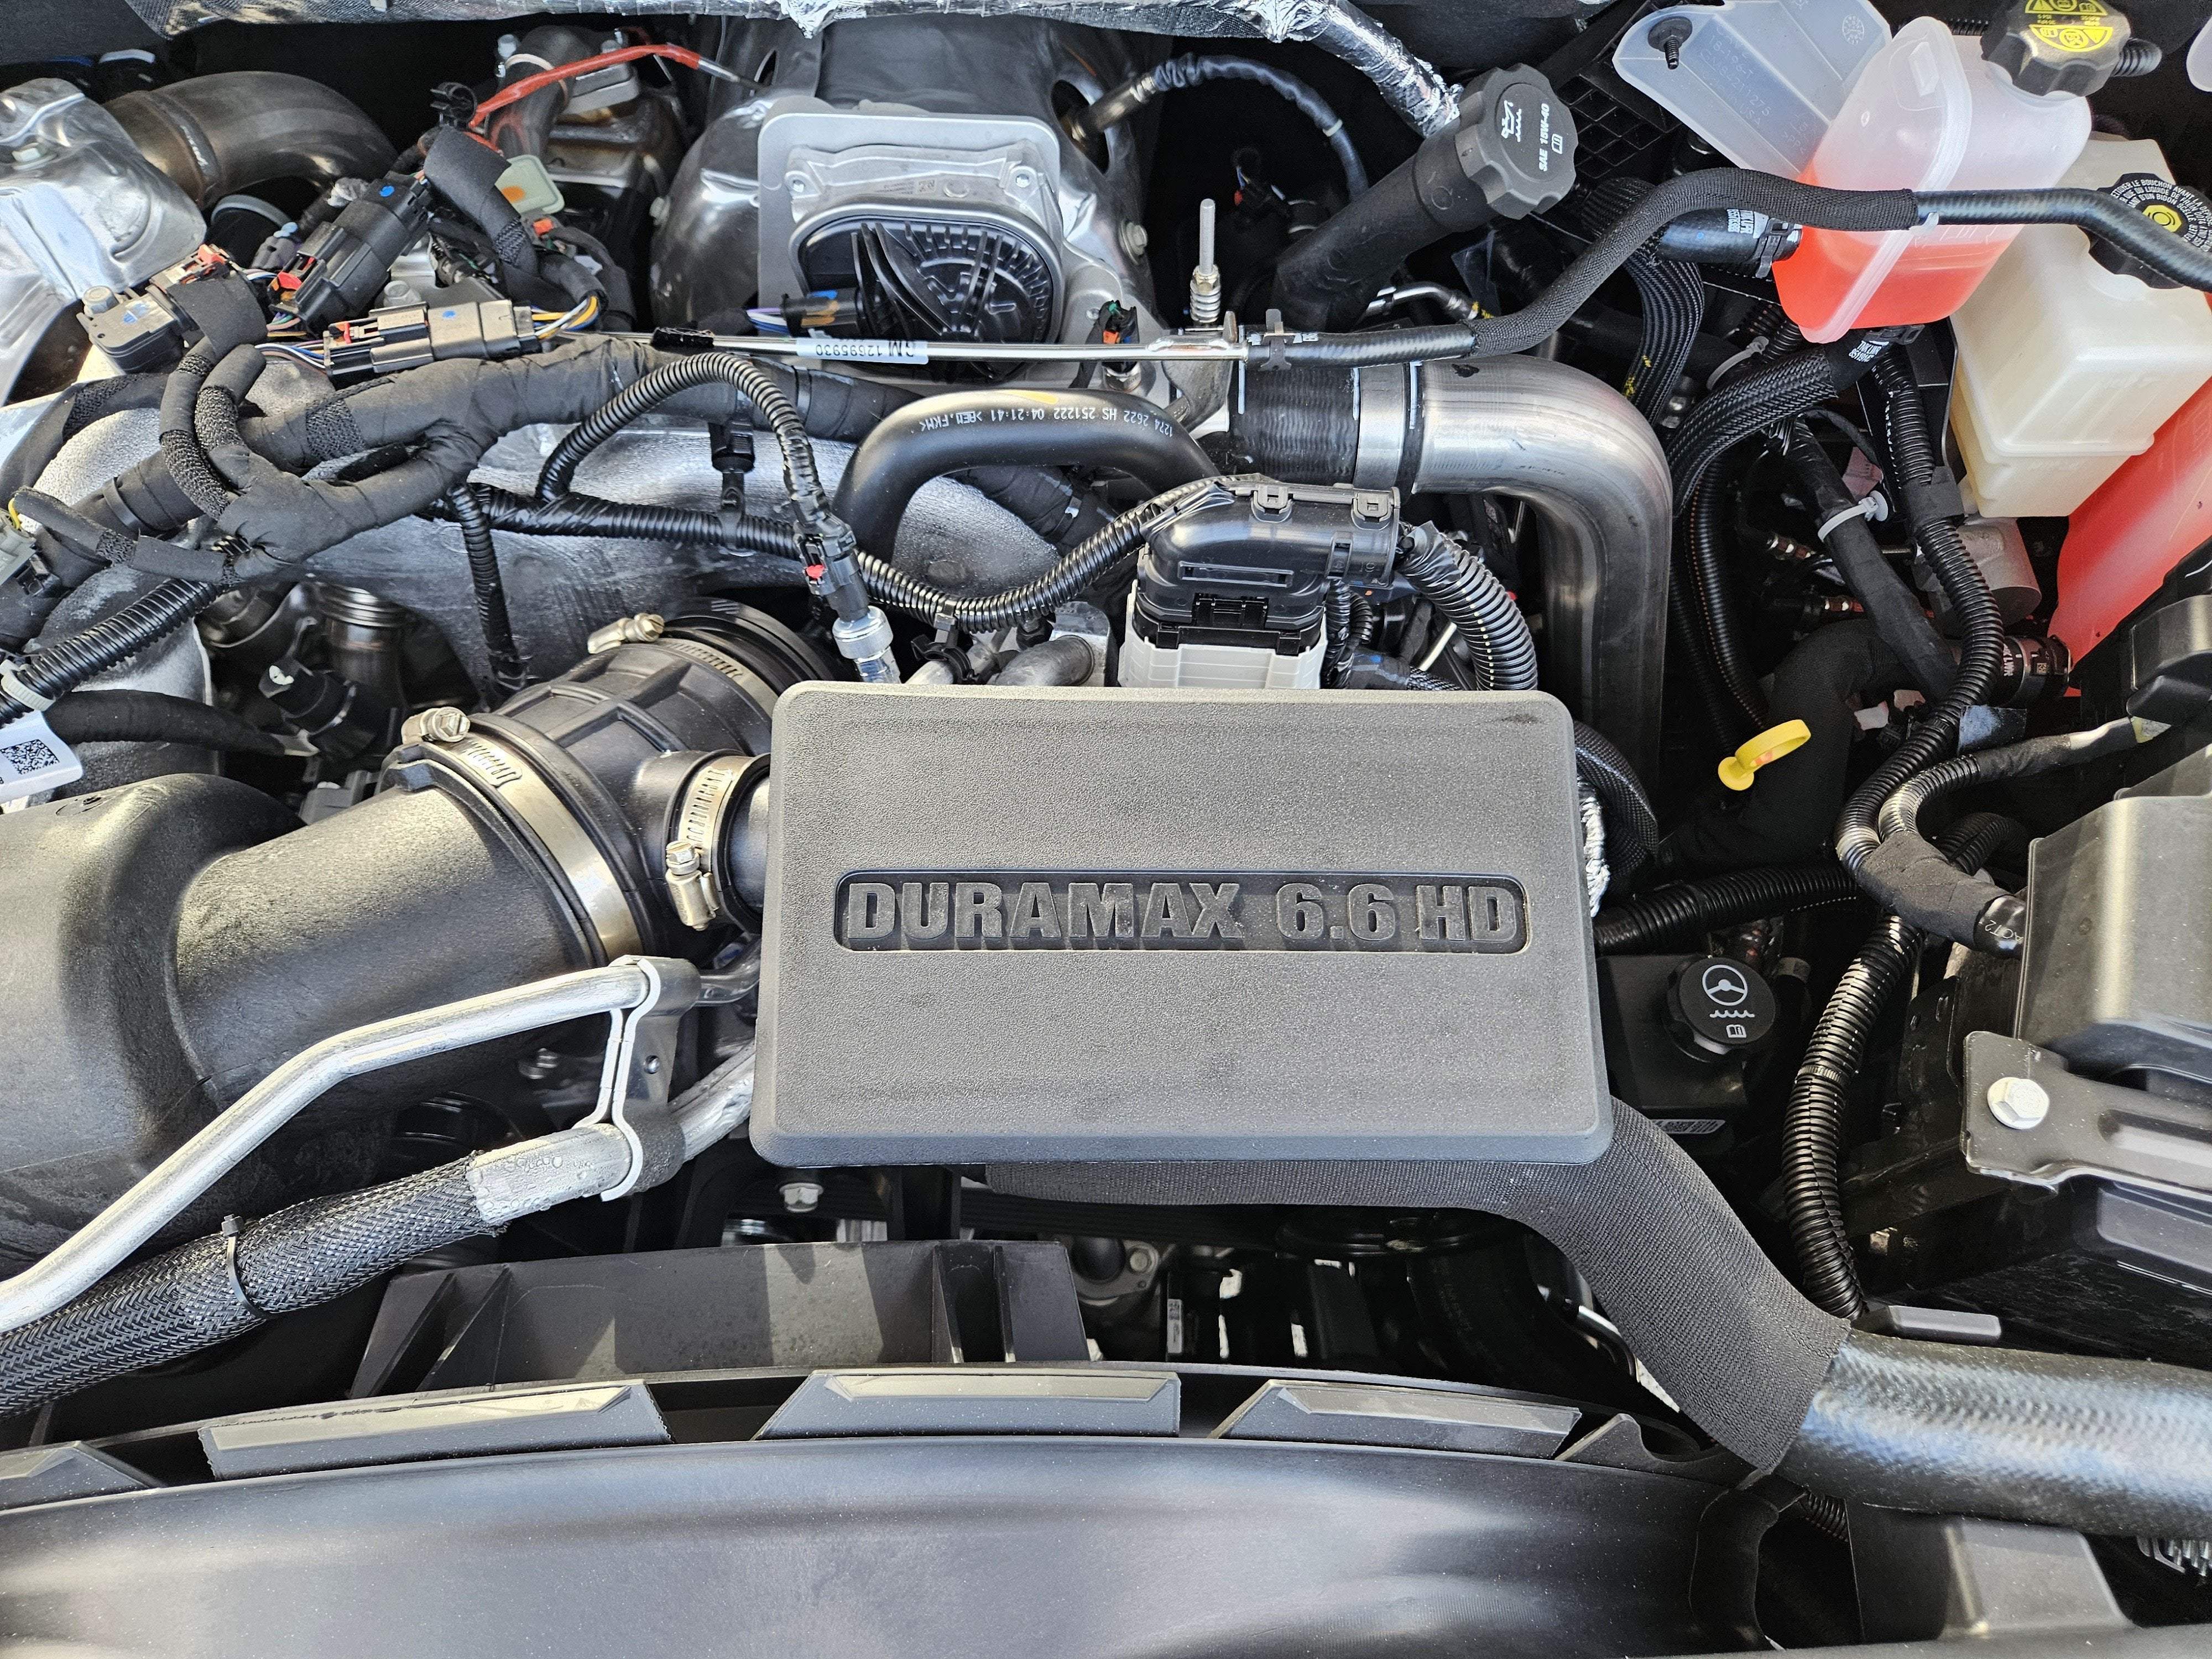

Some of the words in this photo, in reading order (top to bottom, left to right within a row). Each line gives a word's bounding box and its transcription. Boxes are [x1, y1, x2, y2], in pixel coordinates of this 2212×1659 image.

[1539, 103, 1550, 144] 15W-40
[1539, 148, 1548, 172] SAE
[2110, 182, 2133, 199] ETTOYER
[2131, 179, 2141, 187] LE
[2141, 179, 2172, 190] BOUCHON
[2173, 186, 2195, 200] AVANT
[2193, 198, 2203, 207] LA
[2145, 186, 2170, 195] LIQUIDE
[2171, 191, 2180, 200] DE
[2179, 196, 2199, 212] FREIN
[2156, 194, 2178, 205] BIDON
[1740, 220, 1754, 234] UPR
[816, 344, 883, 357] 12695930
[889, 340, 916, 357] GM
[990, 408, 1045, 422] 04:21:41
[1053, 407, 1095, 420] 251222
[1102, 409, 1117, 420] HS
[1123, 410, 1149, 427] 2622
[2003, 657, 2014, 676] LWR
[847, 882, 1244, 940] DURAMAX
[1277, 883, 1395, 941] 6.6
[1415, 885, 1517, 942] HD
